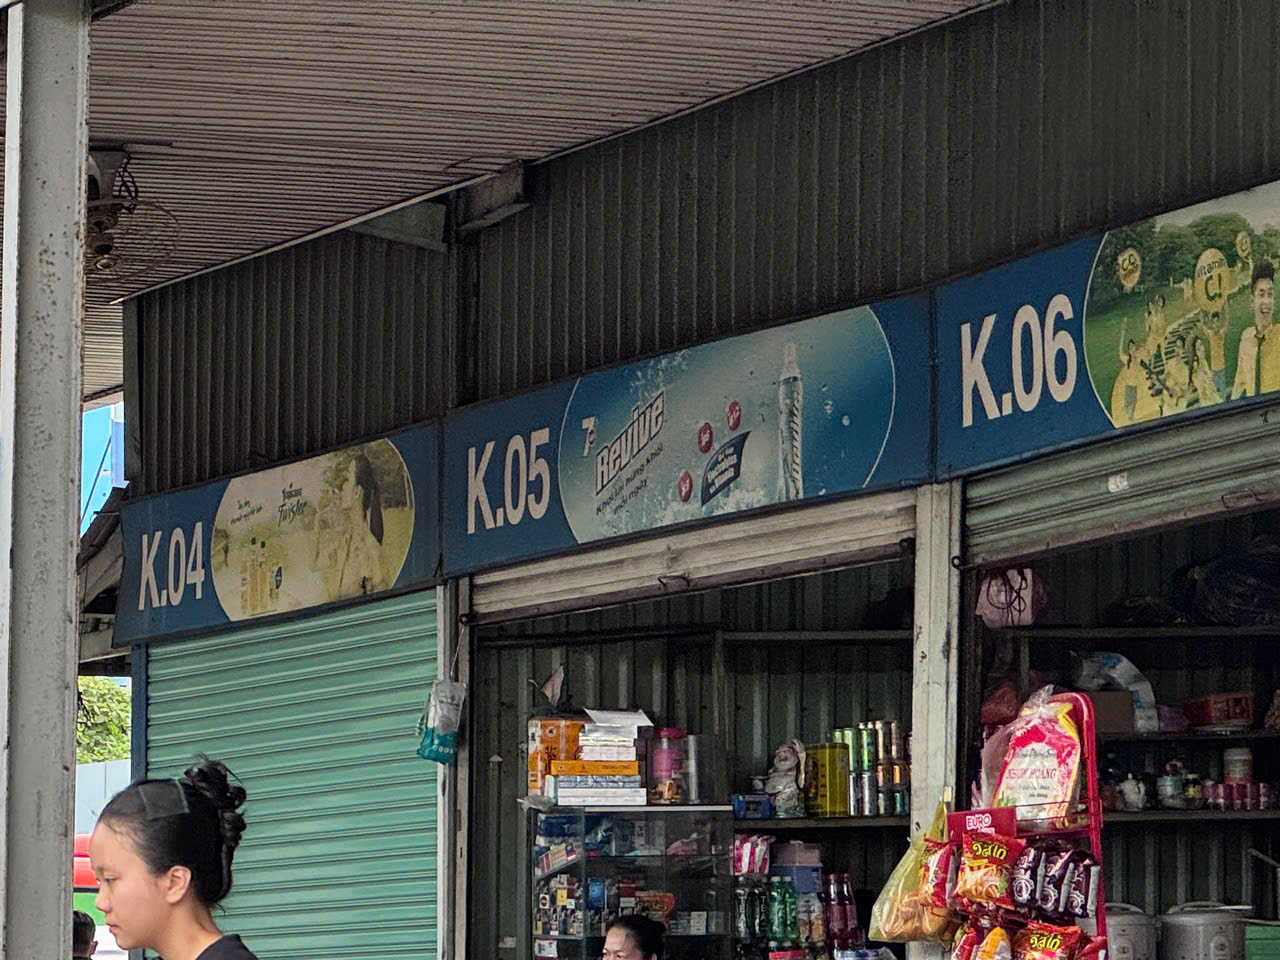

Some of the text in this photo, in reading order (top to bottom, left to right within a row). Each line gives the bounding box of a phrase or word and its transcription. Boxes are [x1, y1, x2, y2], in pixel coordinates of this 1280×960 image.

[961, 294, 1078, 428] K.06
[467, 427, 551, 534] K.05
[596, 390, 665, 496] Revive
[138, 521, 205, 610] K.04
[966, 814, 992, 830] EURO
